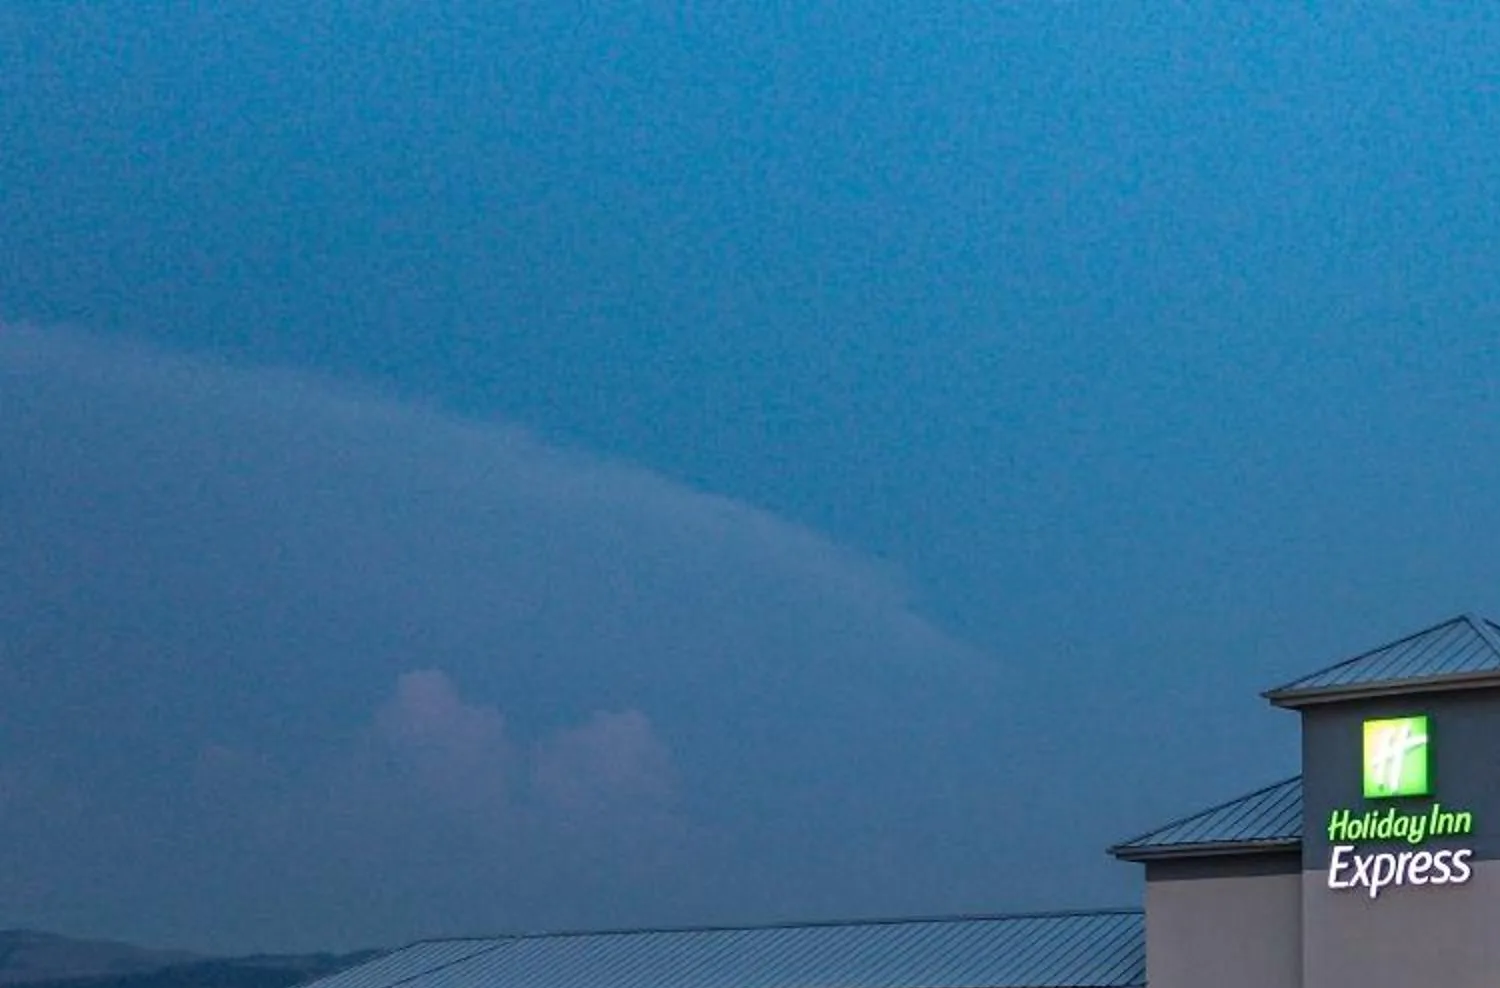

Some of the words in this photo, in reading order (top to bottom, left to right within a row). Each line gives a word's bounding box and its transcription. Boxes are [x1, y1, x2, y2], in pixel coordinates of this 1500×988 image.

[1328, 808, 1426, 844] Holiday
[1429, 803, 1472, 835] Inn
[1328, 845, 1473, 899] Express
